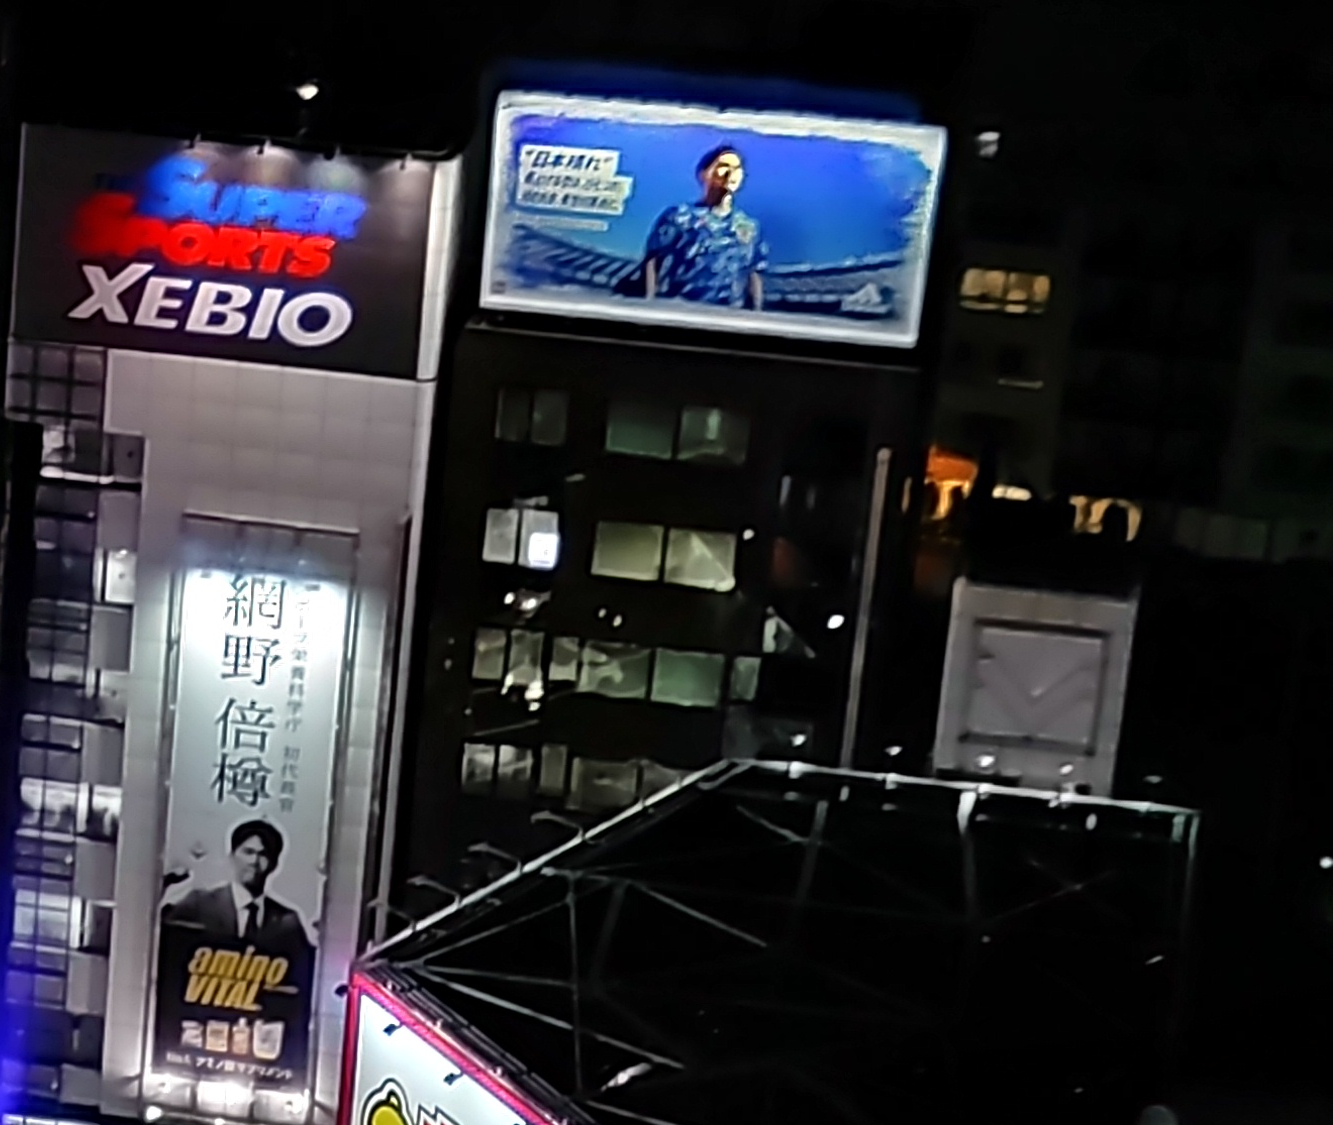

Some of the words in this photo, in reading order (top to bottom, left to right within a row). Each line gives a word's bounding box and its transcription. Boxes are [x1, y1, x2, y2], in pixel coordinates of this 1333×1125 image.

[67, 263, 353, 348] XEBIO
[188, 945, 289, 985] amino
[184, 974, 263, 1012] VITAL
